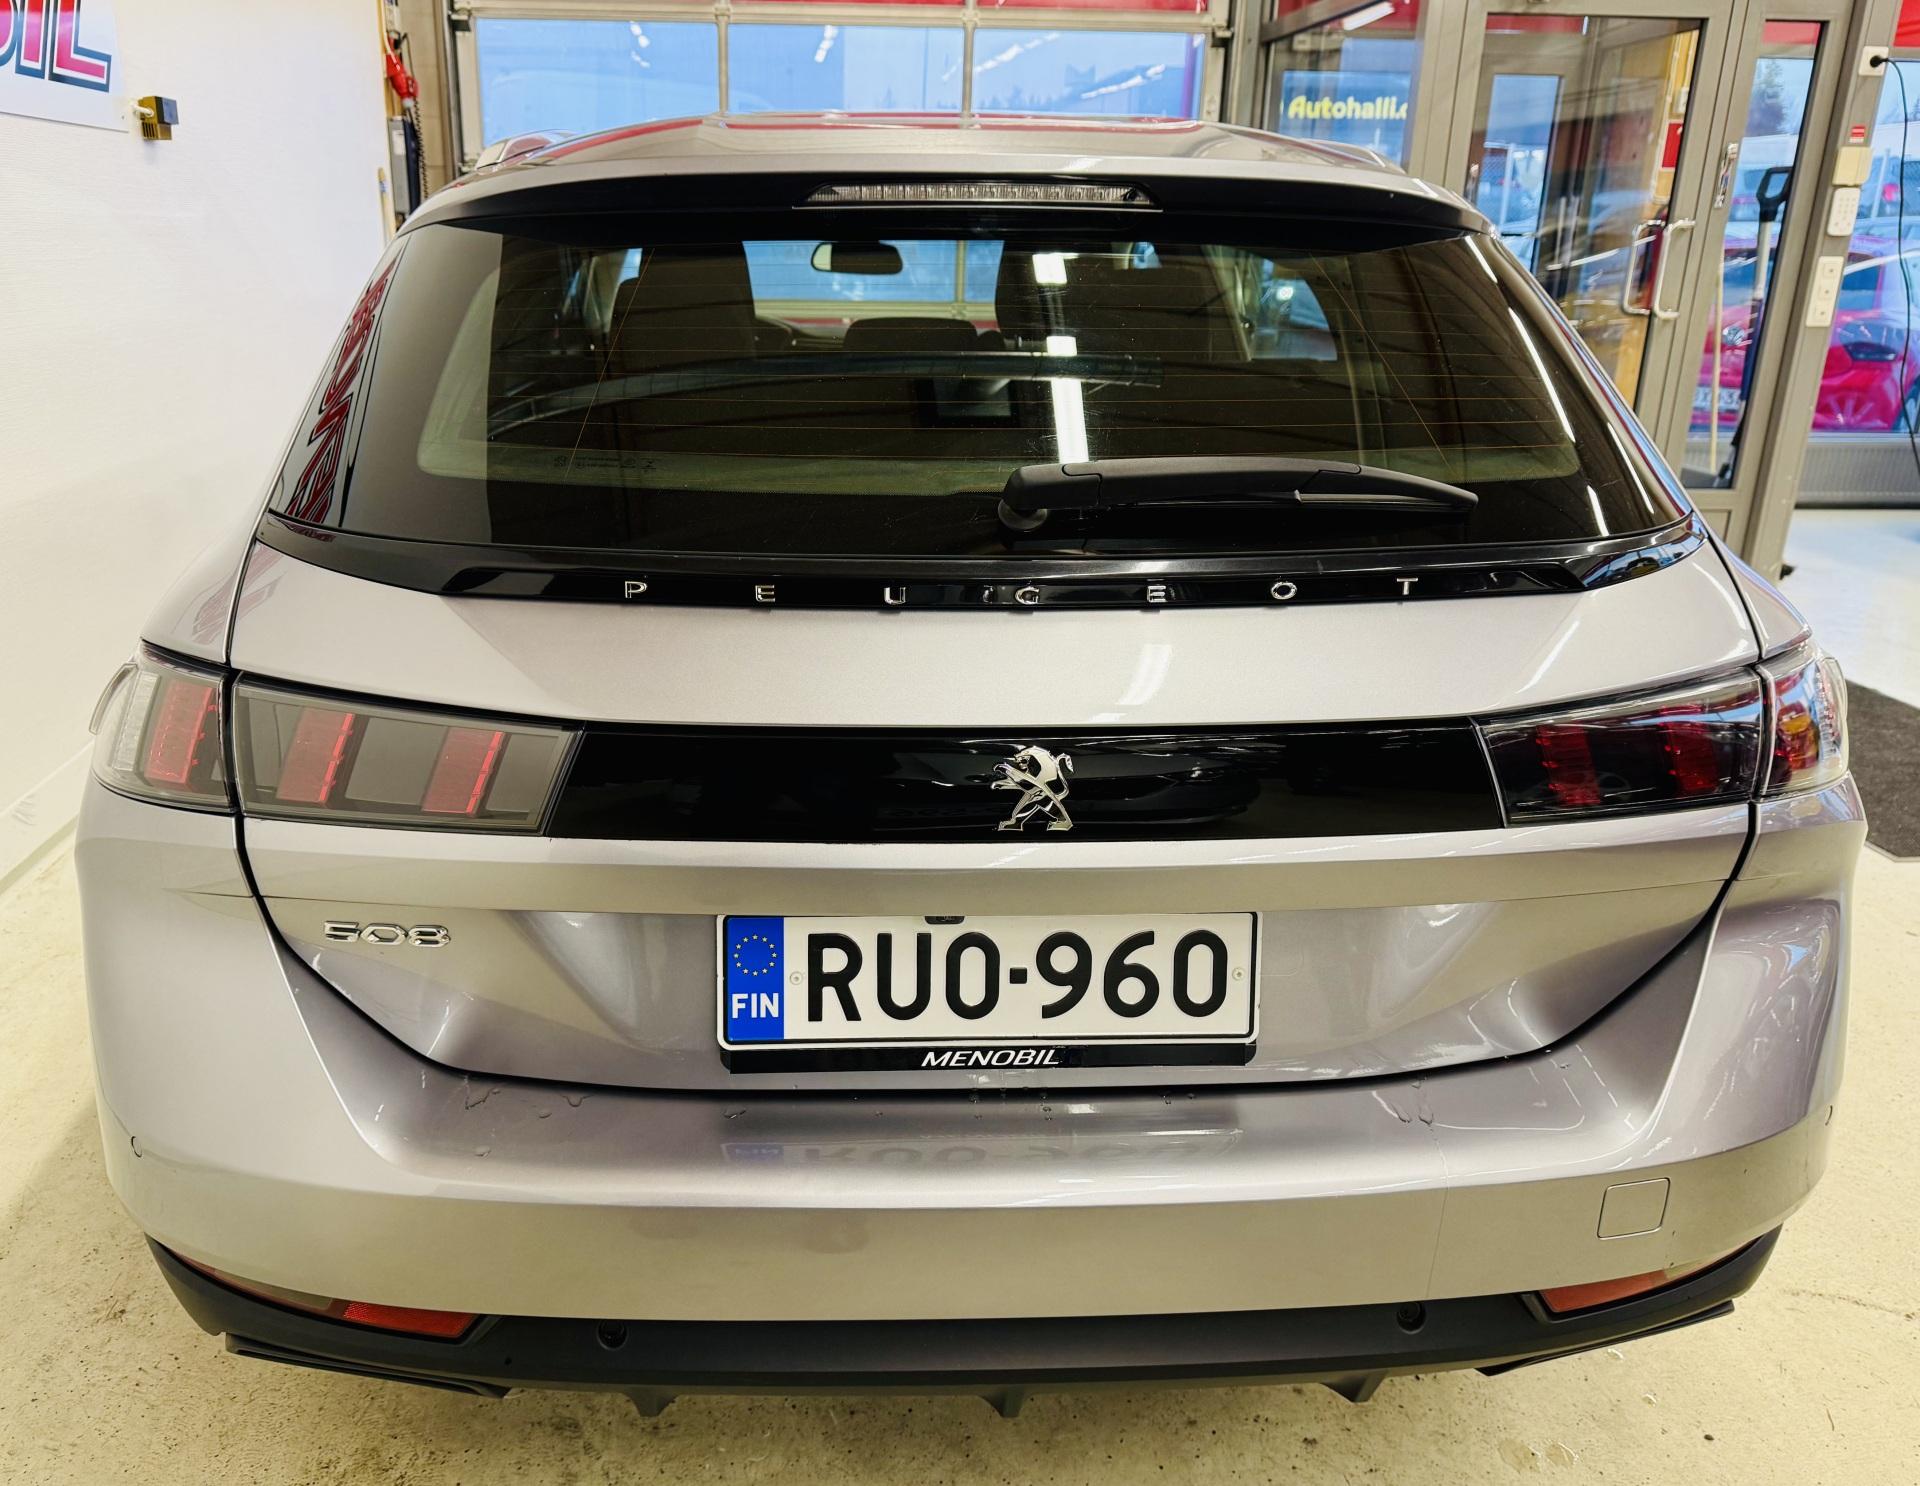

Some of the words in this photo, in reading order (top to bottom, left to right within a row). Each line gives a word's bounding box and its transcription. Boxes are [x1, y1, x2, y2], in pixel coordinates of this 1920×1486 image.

[0, 0, 112, 93] IL
[624, 578, 1419, 605] PEUGEOT
[324, 920, 451, 948] 508
[806, 929, 1229, 1022] RUO-960
[731, 992, 779, 1019] FIN
[921, 1049, 1061, 1067] MENOBIL
